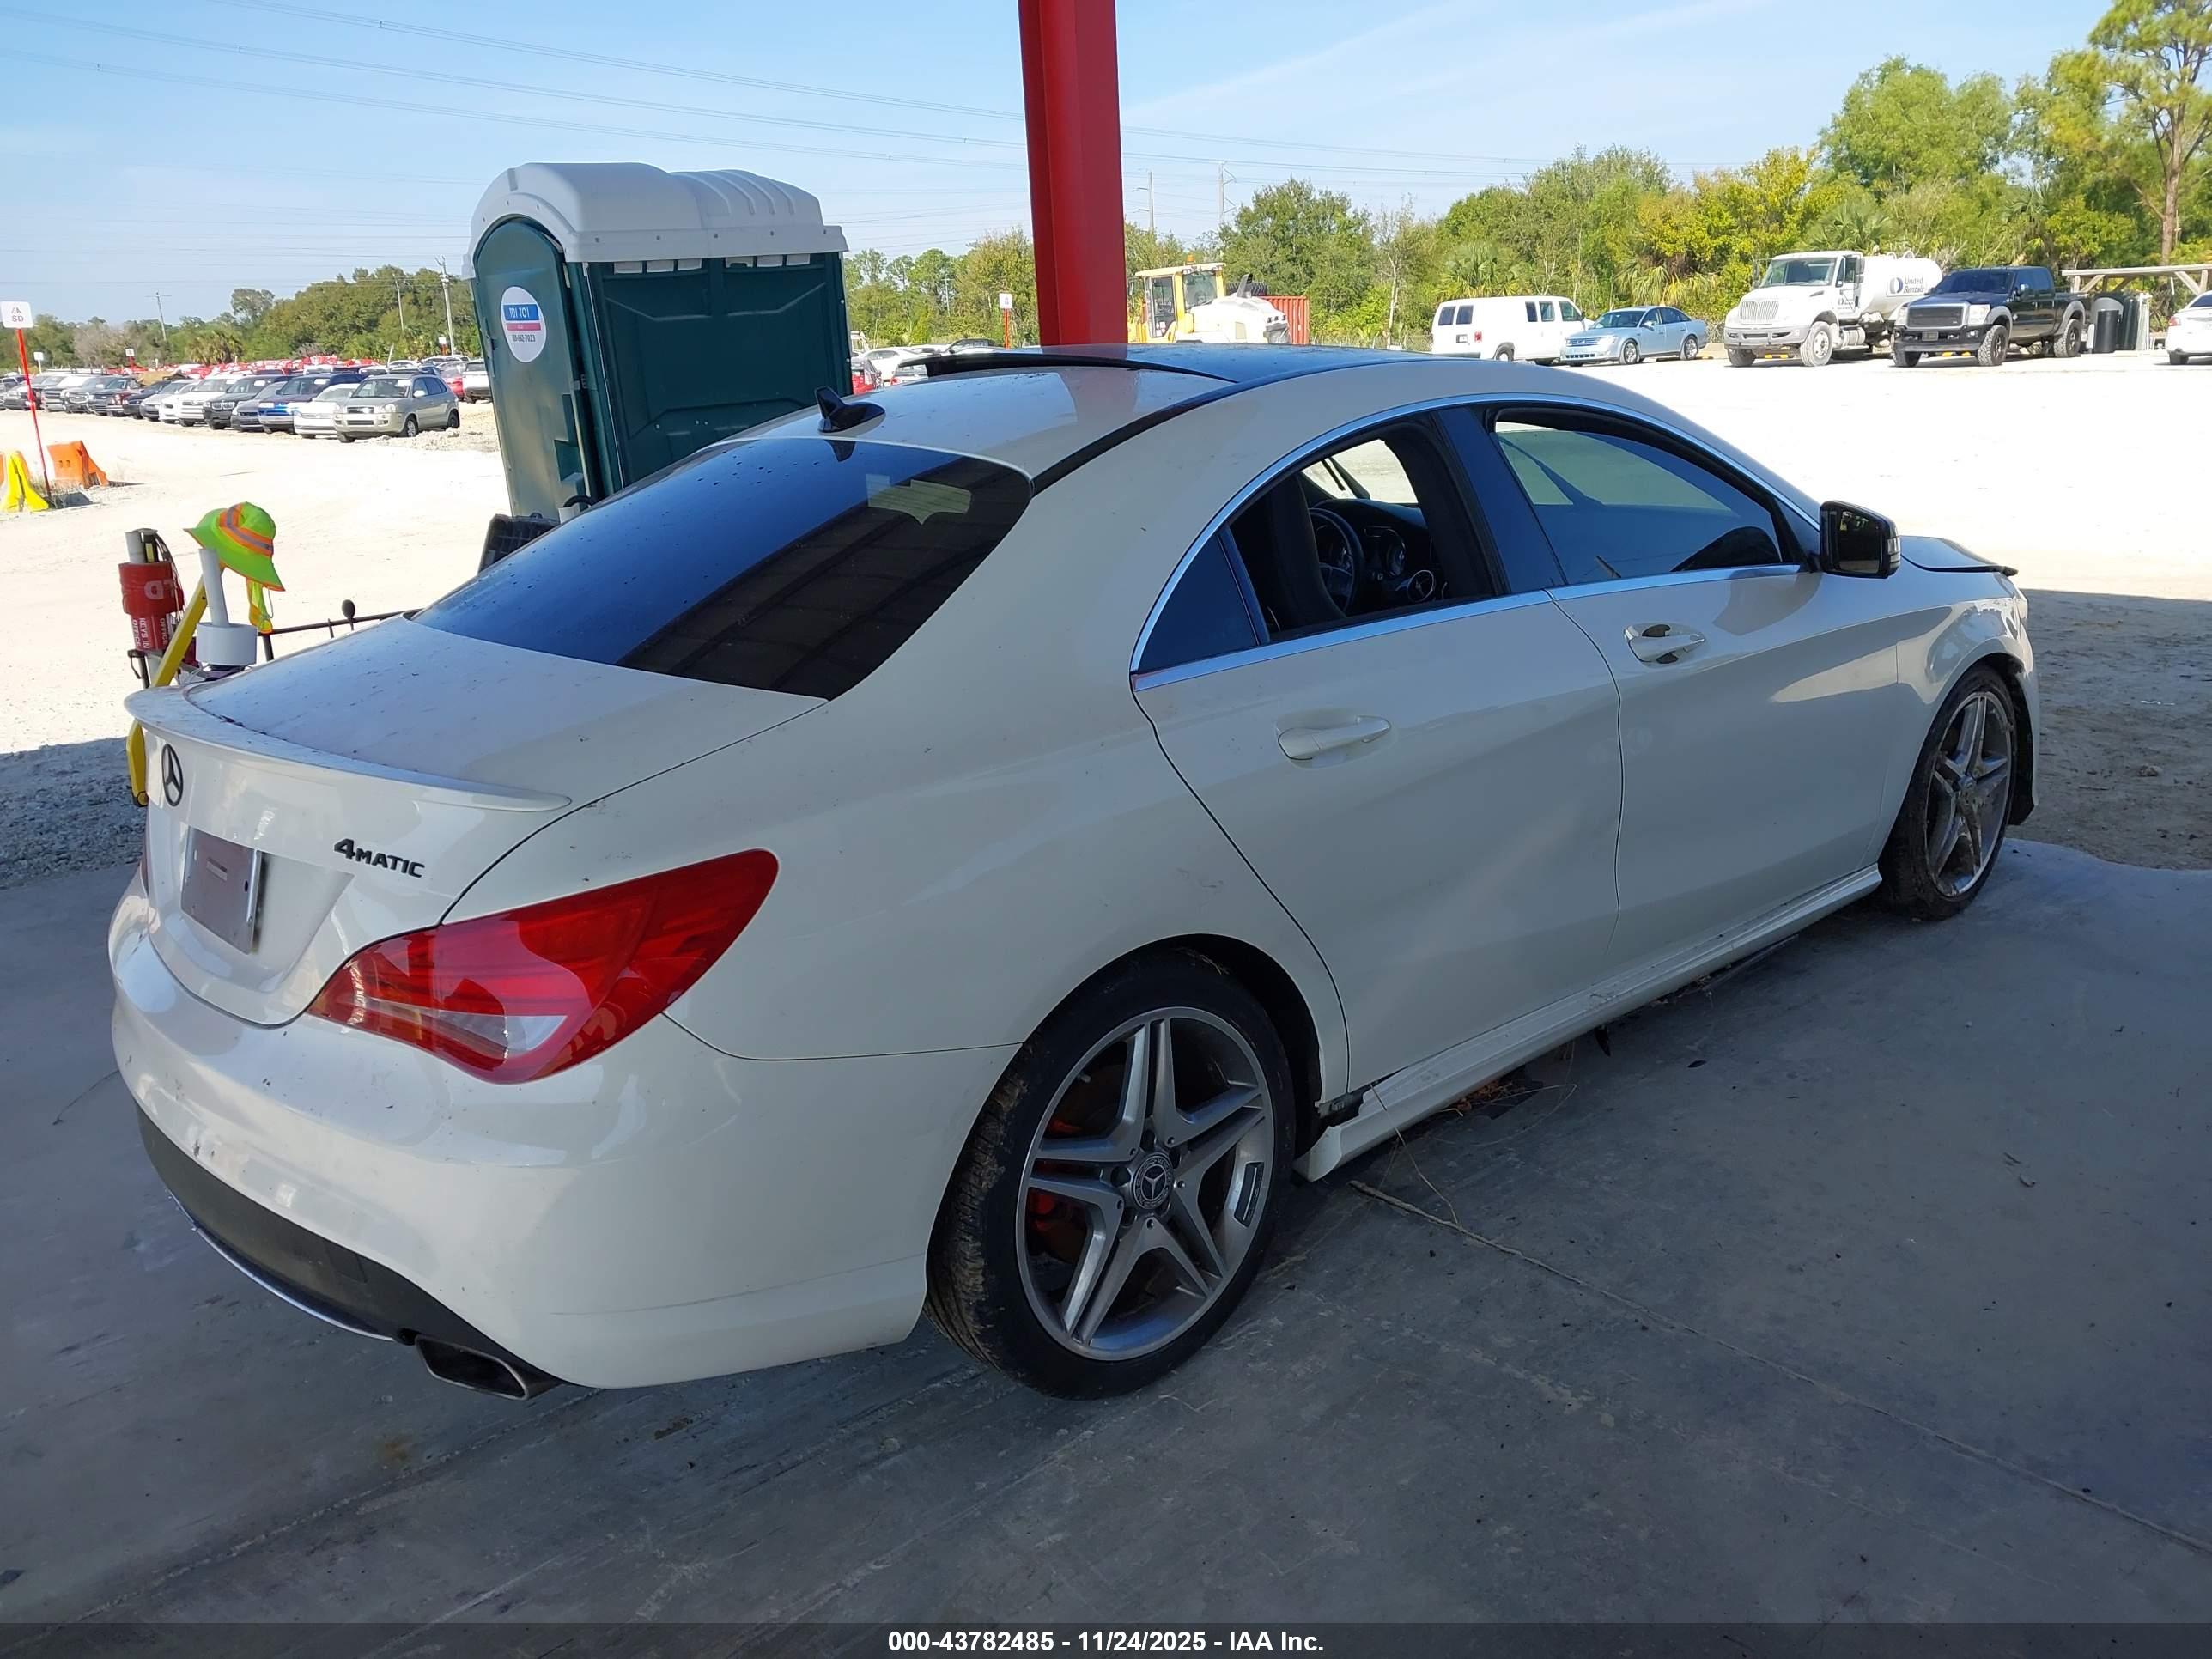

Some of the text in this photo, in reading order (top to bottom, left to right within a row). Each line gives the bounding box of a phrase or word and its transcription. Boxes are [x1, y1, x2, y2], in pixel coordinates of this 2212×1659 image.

[1904, 276, 1923, 285] United
[508, 306, 530, 318] TOI TOI
[132, 619, 142, 647] OFFICE
[138, 617, 149, 638] KEYS
[333, 837, 426, 879] 4MATIC
